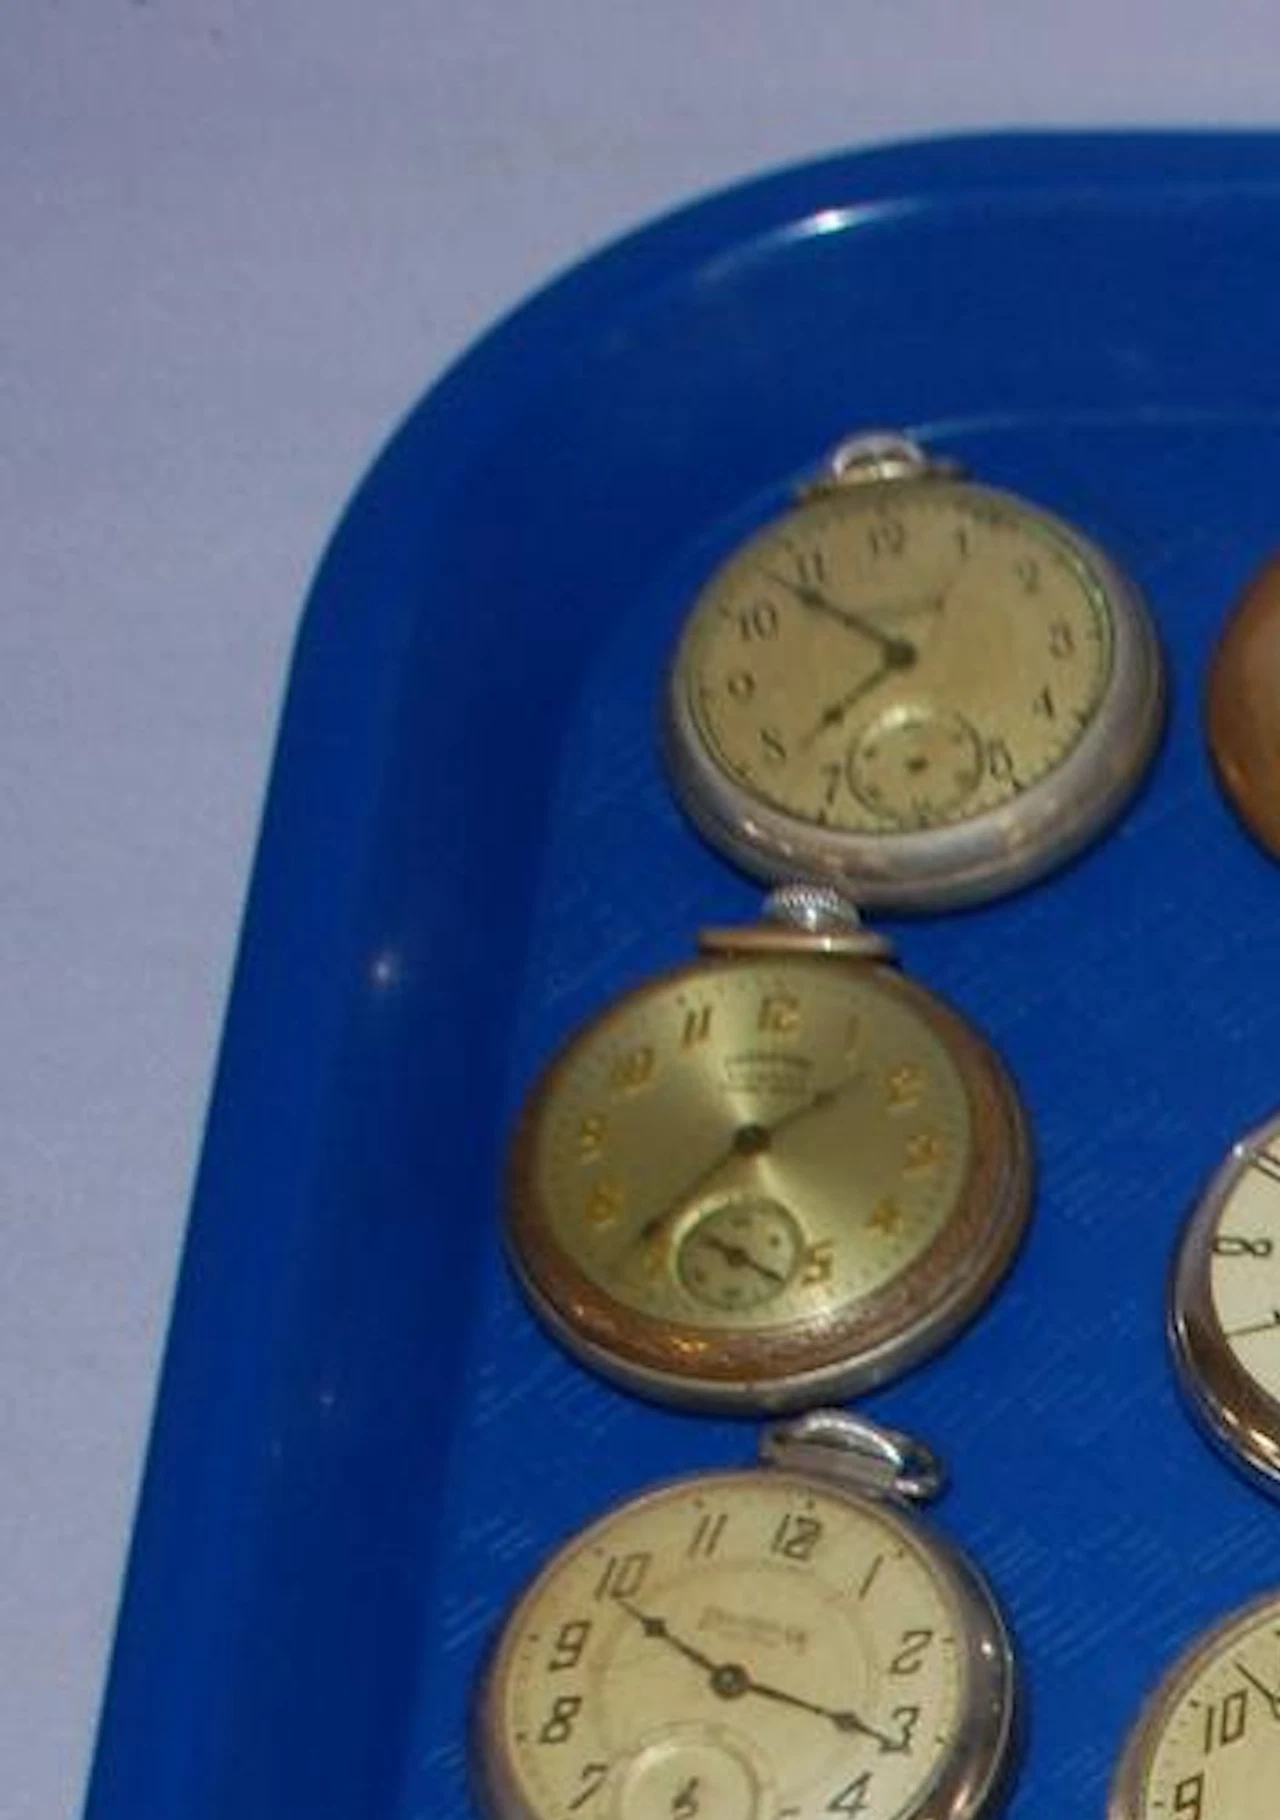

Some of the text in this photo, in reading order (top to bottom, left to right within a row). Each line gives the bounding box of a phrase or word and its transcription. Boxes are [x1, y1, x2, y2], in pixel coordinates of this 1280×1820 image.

[686, 1513, 726, 1558] 11
[771, 1513, 823, 1561] 12
[594, 1552, 650, 1601] 10
[549, 1619, 591, 1671] 9
[890, 1630, 933, 1675] 2
[538, 1696, 582, 1744] 8
[880, 1706, 921, 1755] 3
[1203, 1690, 1250, 1753] 10
[568, 1763, 608, 1811] 7
[828, 1772, 872, 1820] 4
